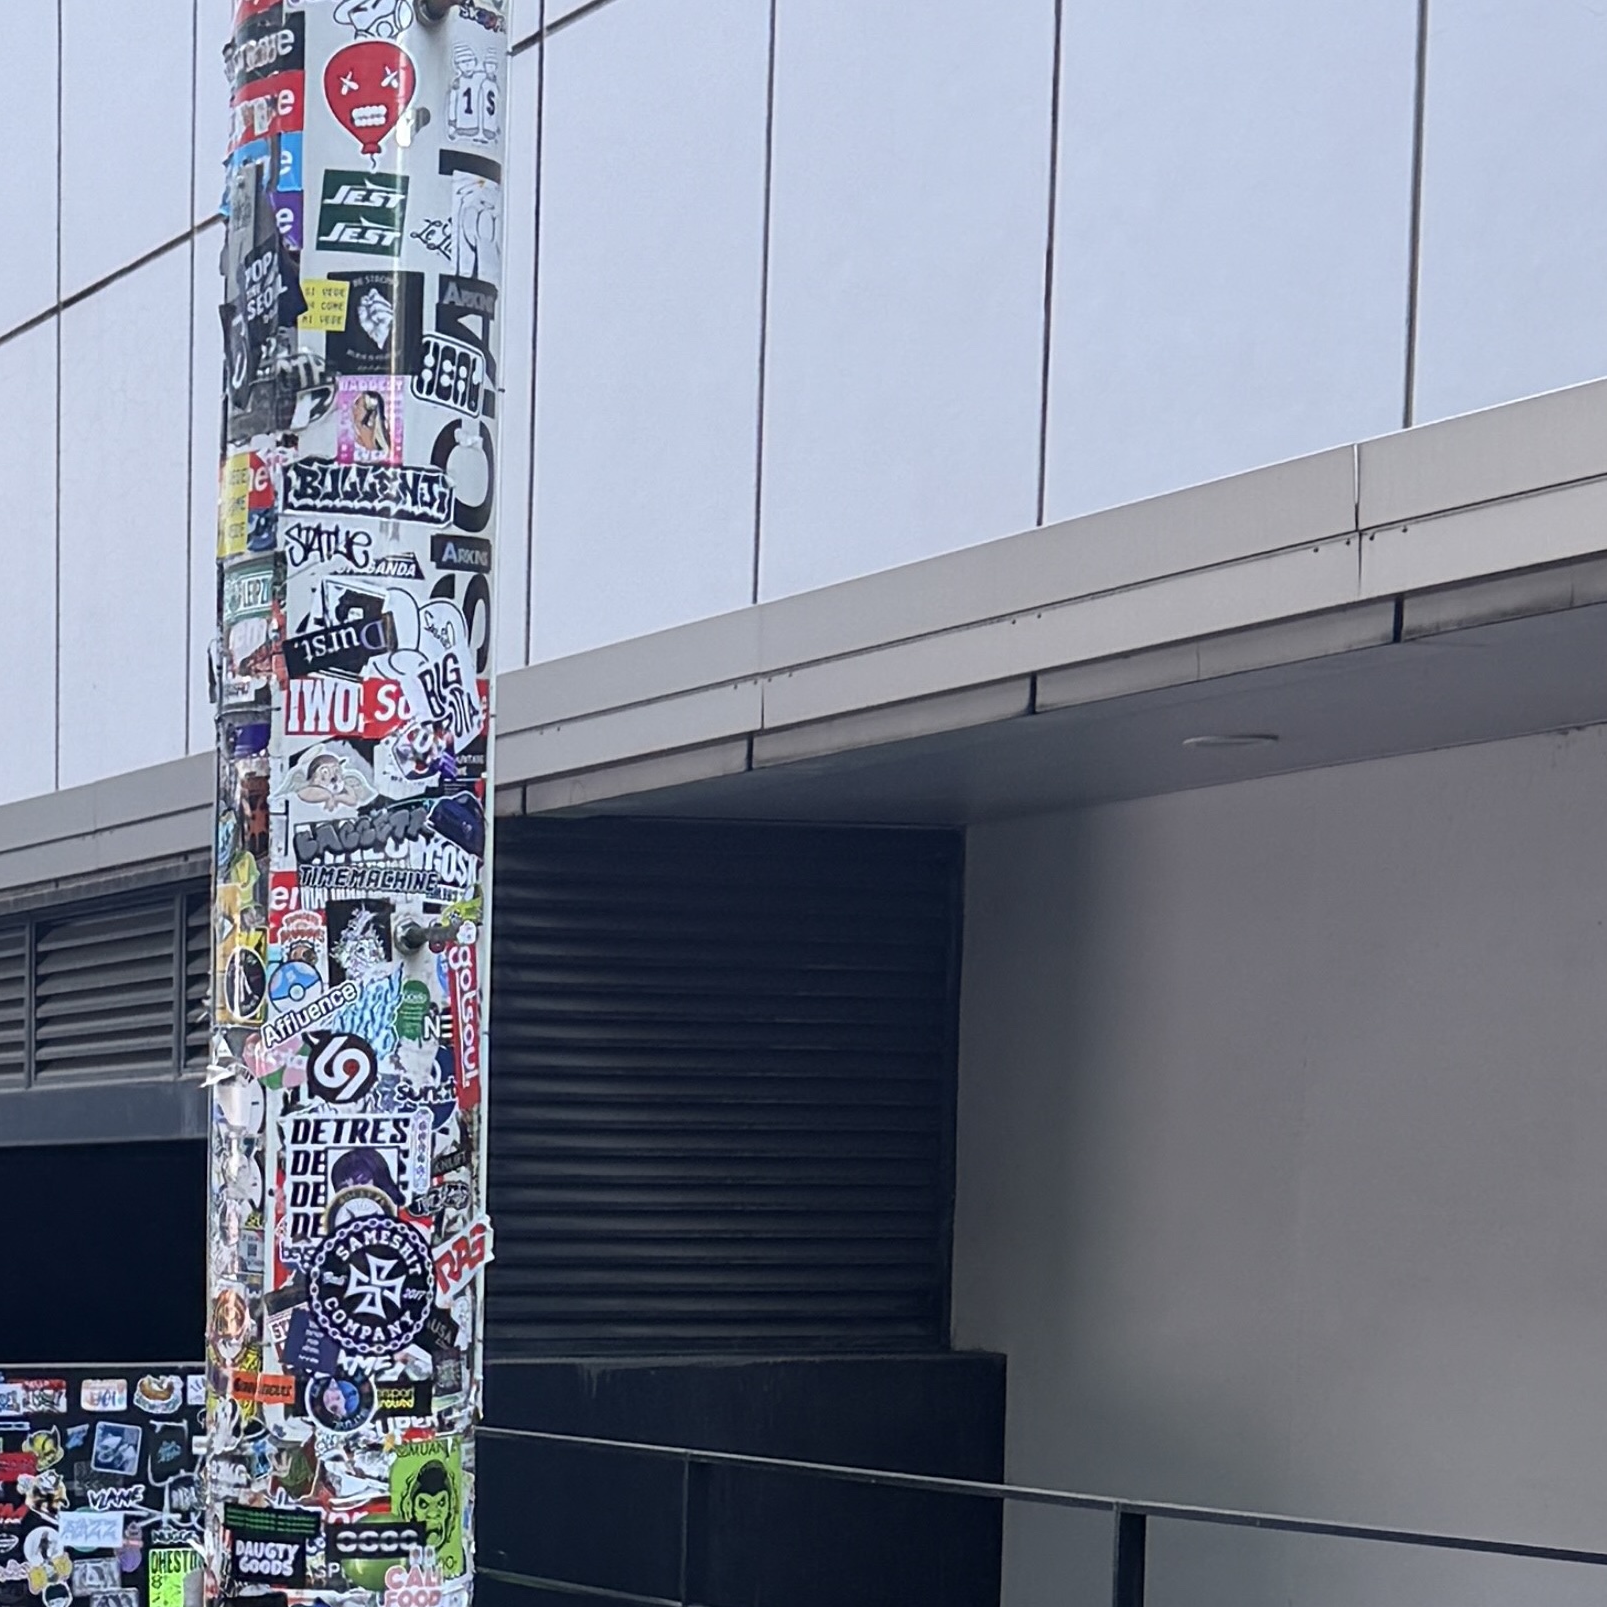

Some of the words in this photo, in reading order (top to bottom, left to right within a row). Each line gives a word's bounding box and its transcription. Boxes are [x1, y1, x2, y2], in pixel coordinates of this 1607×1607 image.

[262, 979, 358, 1049] Affluence
[290, 1117, 410, 1145] DETRES
[324, 1297, 414, 1342] COMPANY
